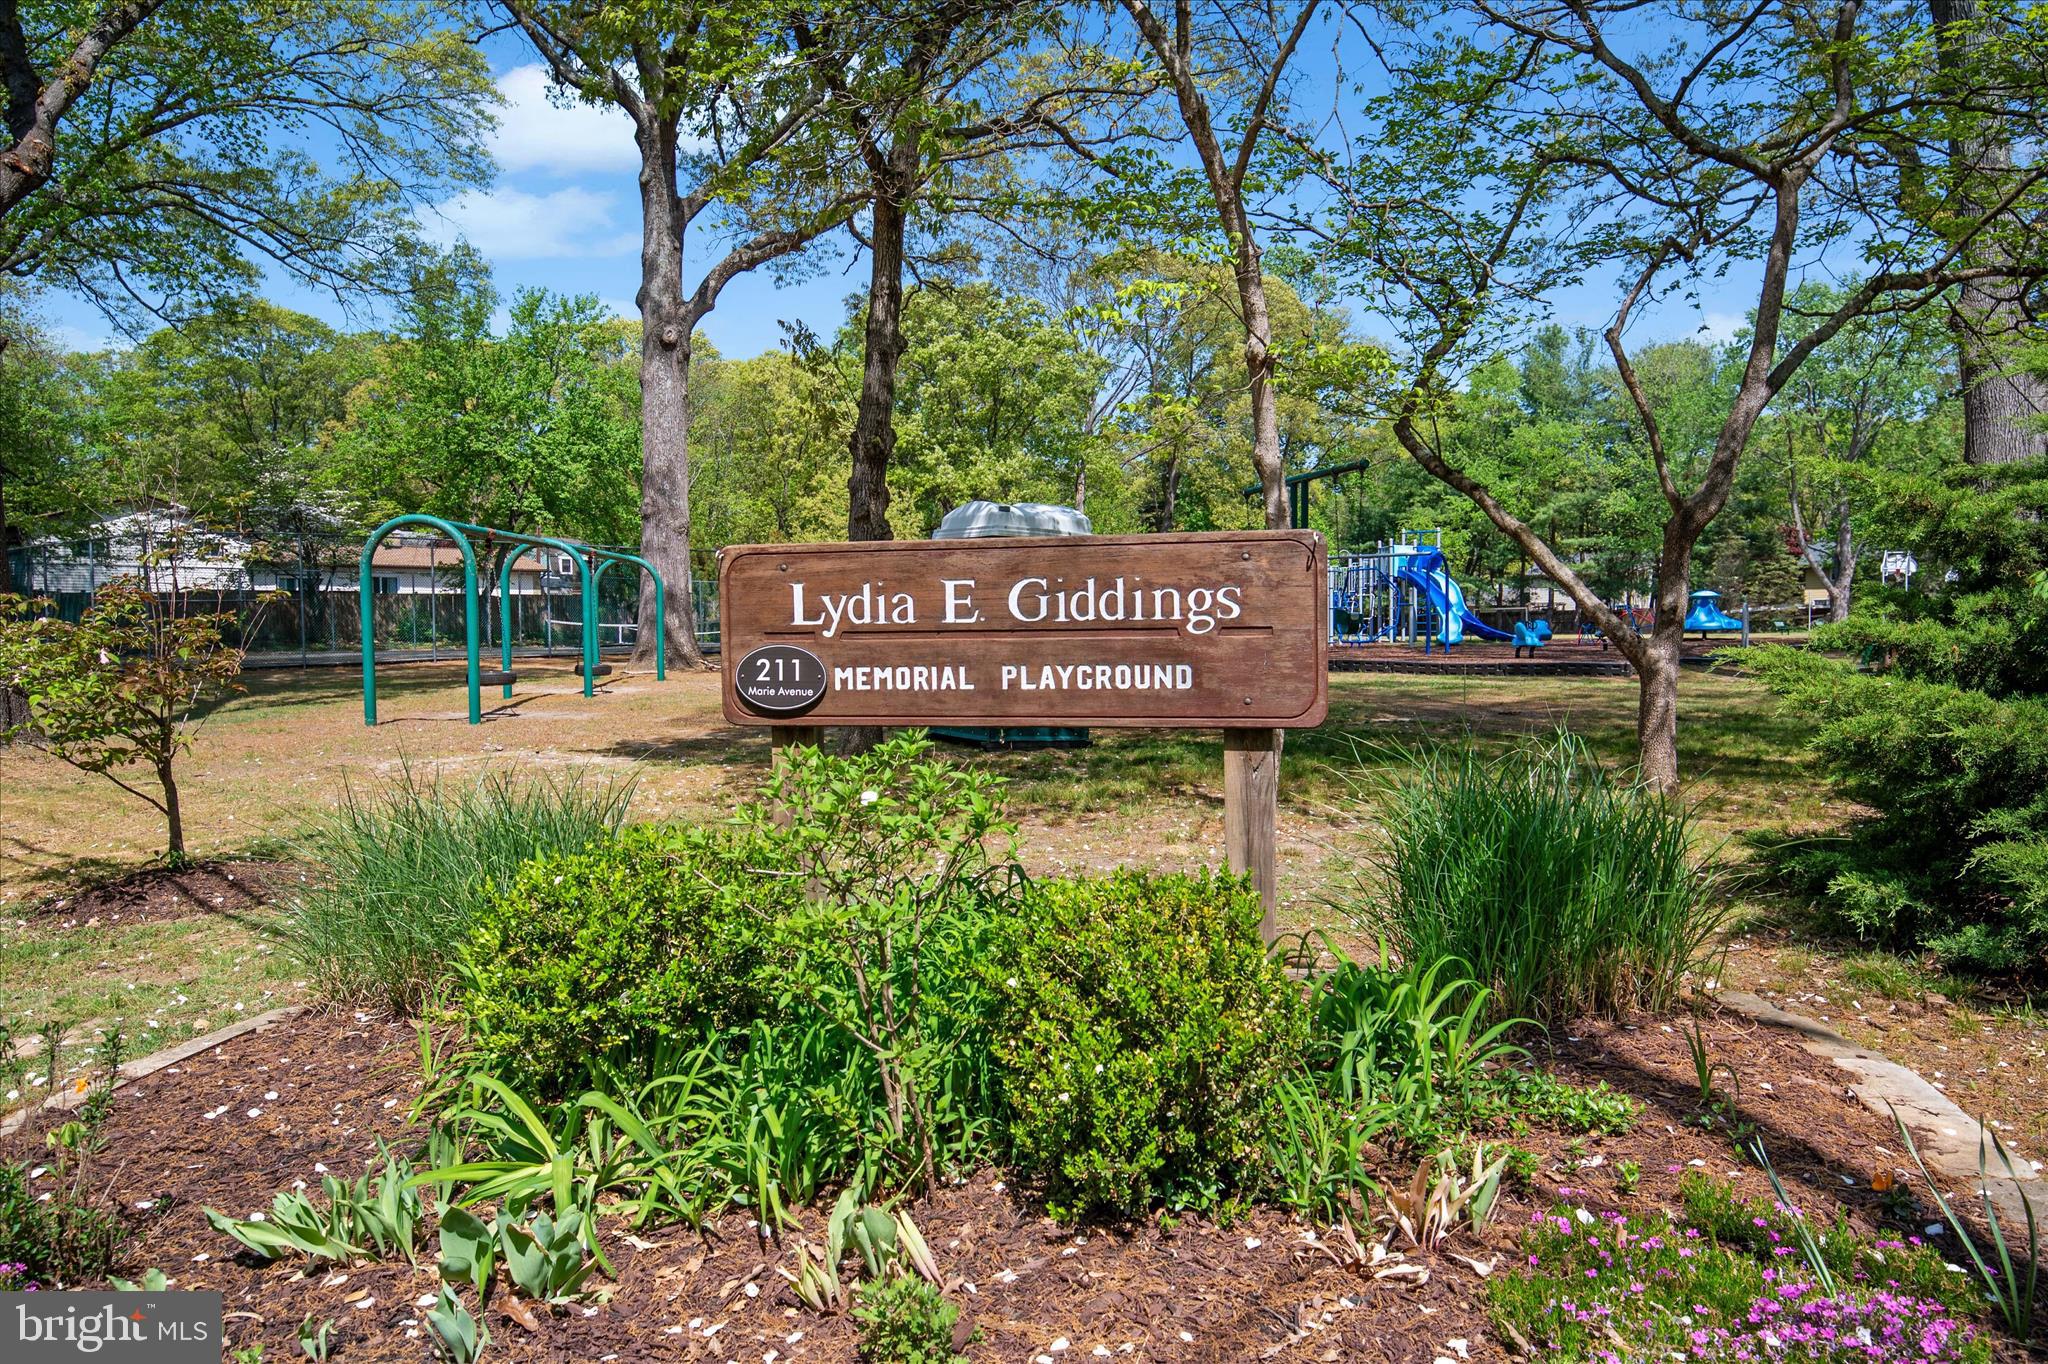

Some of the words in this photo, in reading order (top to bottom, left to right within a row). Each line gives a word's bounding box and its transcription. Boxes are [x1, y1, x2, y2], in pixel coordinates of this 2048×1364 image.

[789, 580, 917, 638] Lydia
[1007, 574, 1242, 635] Giddings
[756, 658, 800, 682] 211
[833, 665, 975, 692] MEMORIAL
[1001, 664, 1194, 690] PLAYGROUND
[748, 686, 776, 696] Marie
[777, 686, 814, 697] Avenue
